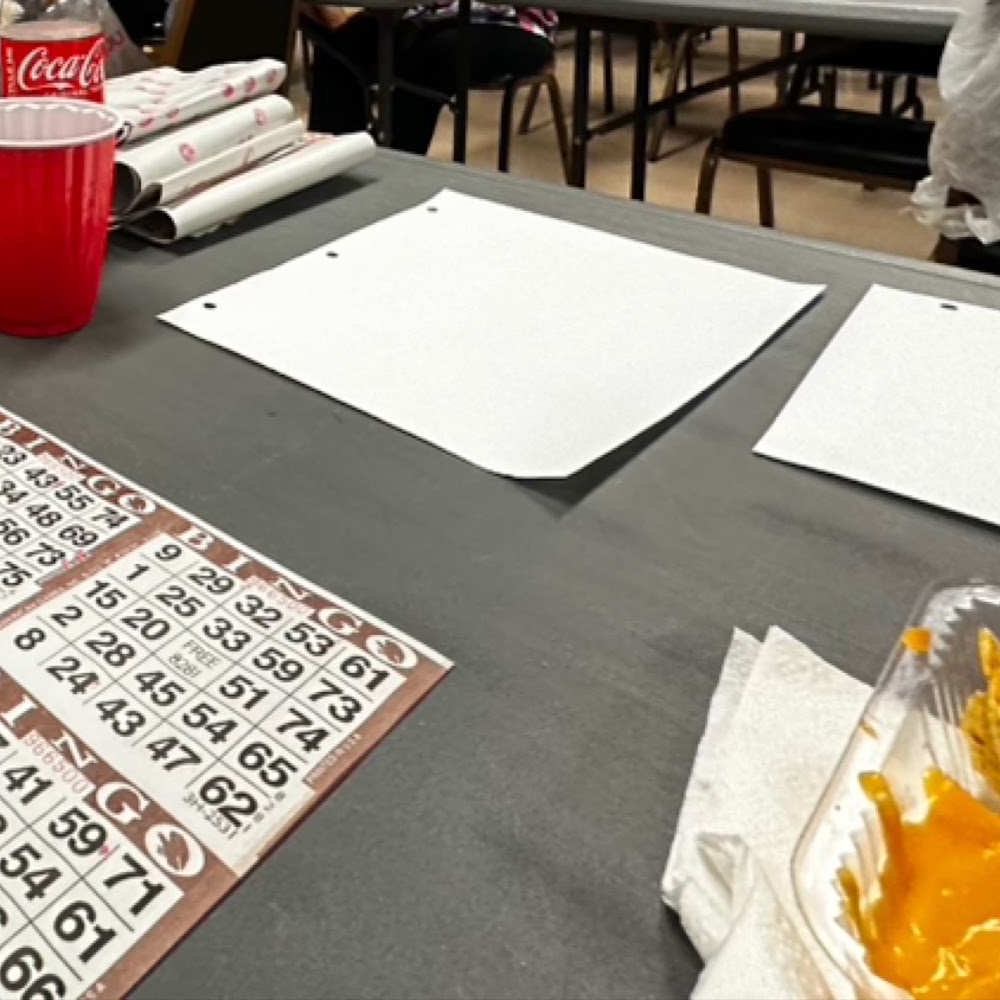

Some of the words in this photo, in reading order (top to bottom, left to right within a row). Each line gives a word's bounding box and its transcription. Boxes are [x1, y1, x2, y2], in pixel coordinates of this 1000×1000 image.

[24, 468, 59, 488] 43
[54, 485, 94, 511] 55
[25, 542, 66, 566] 73
[26, 504, 63, 528] 48
[58, 525, 99, 547] 69
[86, 580, 127, 610] 15
[120, 608, 170, 640] 20
[183, 640, 220, 670] FREE
[219, 675, 270, 711] 51
[276, 708, 330, 753] 74
[126, 564, 150, 581] 1
[155, 585, 206, 617] 25
[202, 618, 252, 652] 33
[252, 647, 304, 682] 59
[308, 678, 362, 723] 73
[155, 544, 182, 562] 9
[188, 566, 234, 595] 29
[235, 594, 283, 629] 32
[284, 622, 336, 657] 53
[340, 656, 390, 692] 61
[14, 628, 46, 650] 8
[46, 656, 99, 695] 24
[96, 699, 146, 737] 43
[146, 736, 202, 771] 47
[199, 776, 258, 828] 62
[50, 606, 83, 628] 2
[84, 631, 136, 667] 28
[135, 671, 186, 706] 45
[182, 702, 238, 744] 54
[238, 742, 298, 788] 65
[3, 765, 54, 805] 41
[48, 807, 108, 856] 59
[103, 853, 165, 916] 71
[53, 900, 117, 964] 61
